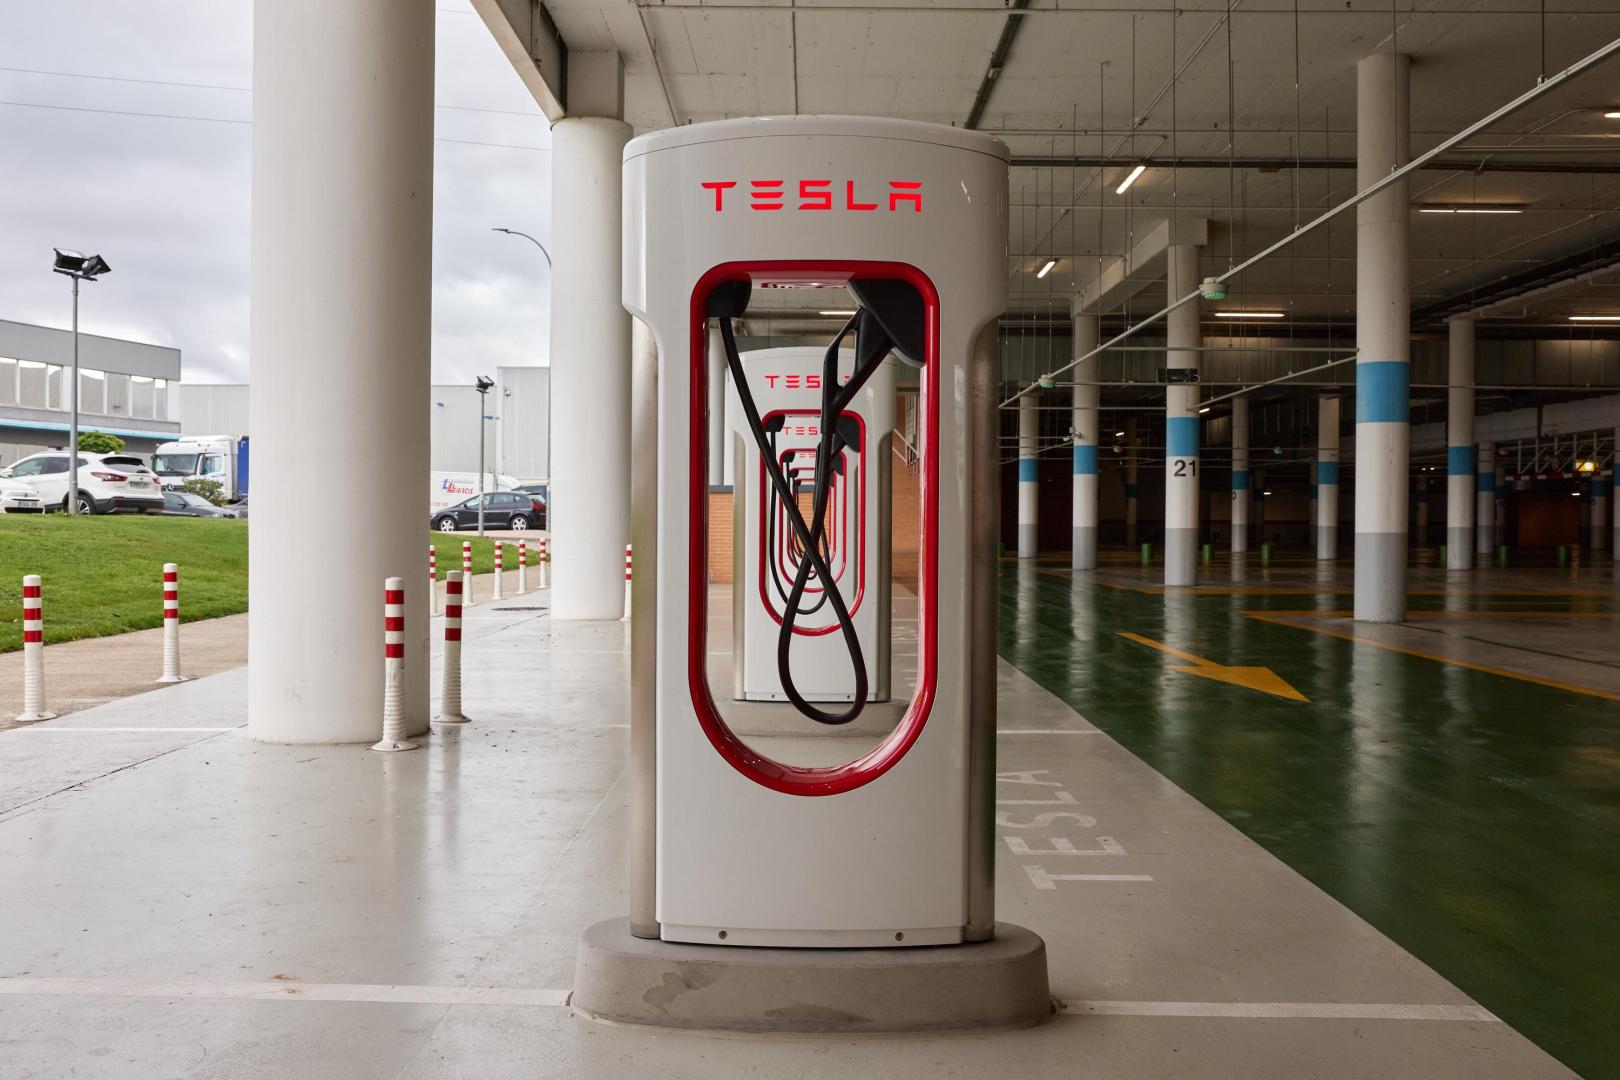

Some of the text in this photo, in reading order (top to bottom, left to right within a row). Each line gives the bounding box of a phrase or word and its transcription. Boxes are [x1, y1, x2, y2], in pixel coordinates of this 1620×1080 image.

[701, 180, 923, 212] TESLA
[1174, 459, 1196, 477] 21
[996, 769, 1156, 890] TESLA
